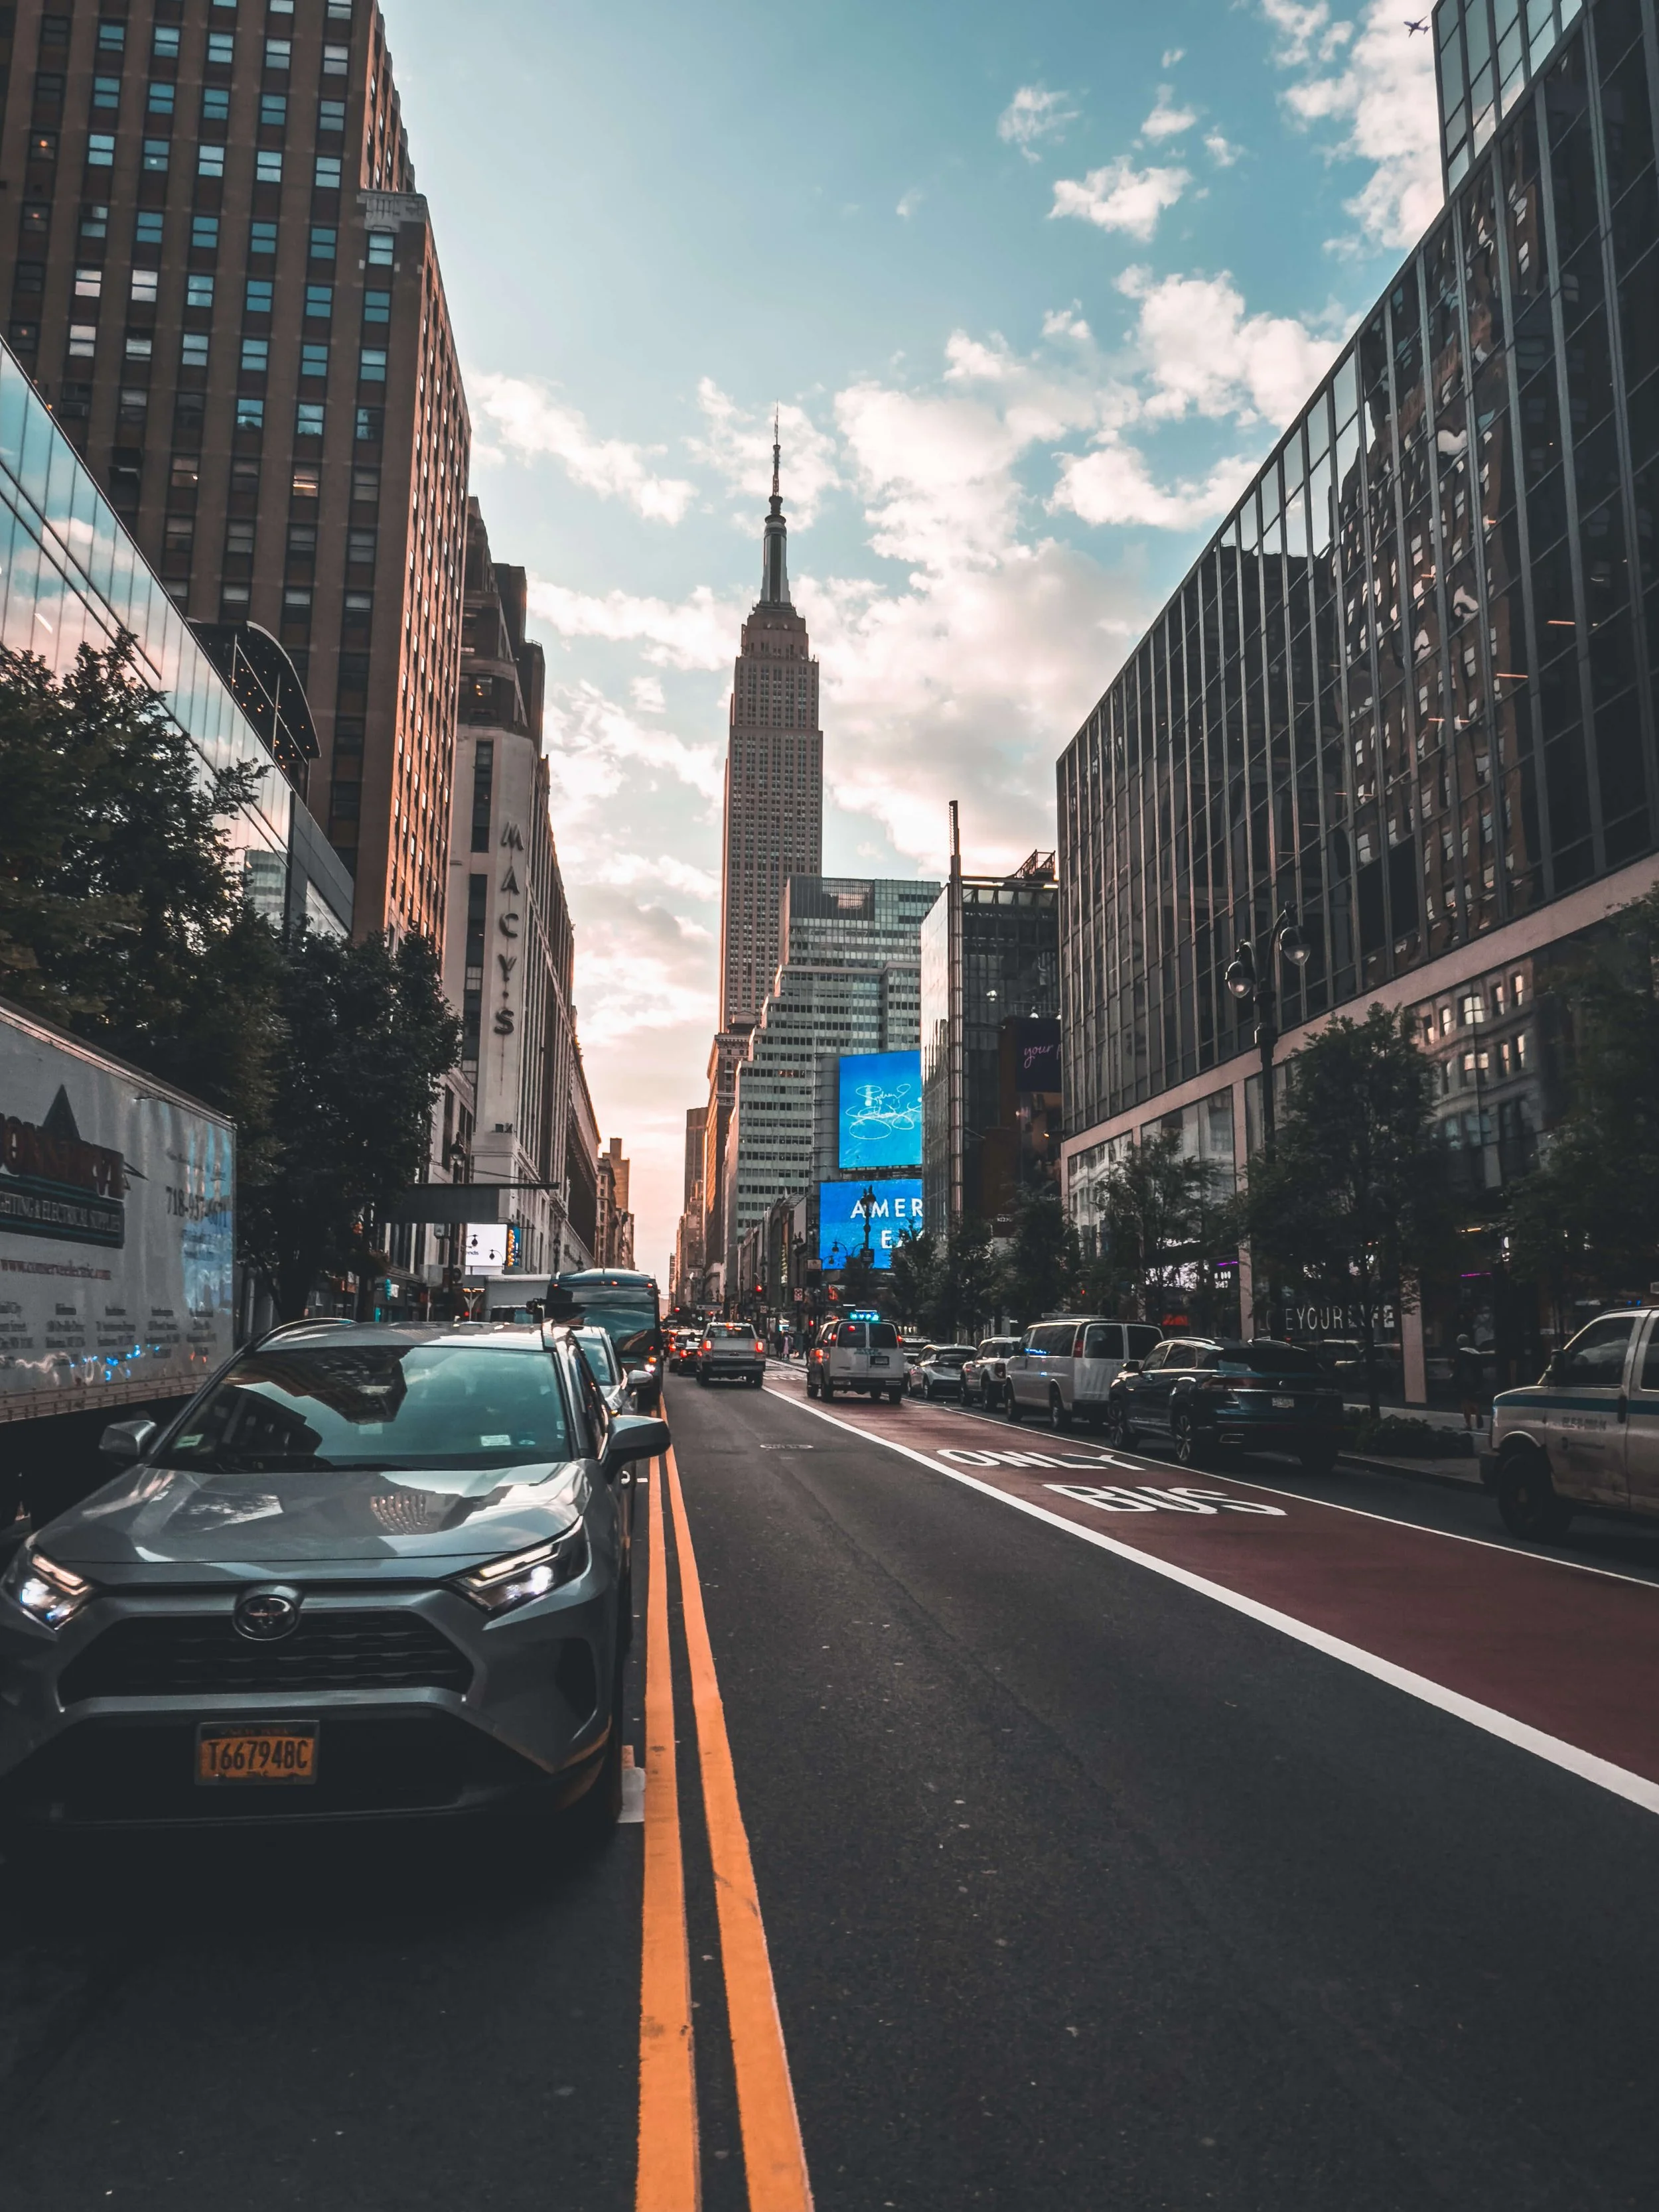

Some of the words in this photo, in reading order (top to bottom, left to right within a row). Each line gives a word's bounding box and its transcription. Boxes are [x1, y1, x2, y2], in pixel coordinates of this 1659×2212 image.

[1024, 1044, 1054, 1069] your
[850, 1198, 923, 1219] AMER
[936, 1449, 1146, 1470] ONLY
[1043, 1484, 1288, 1515] BUS
